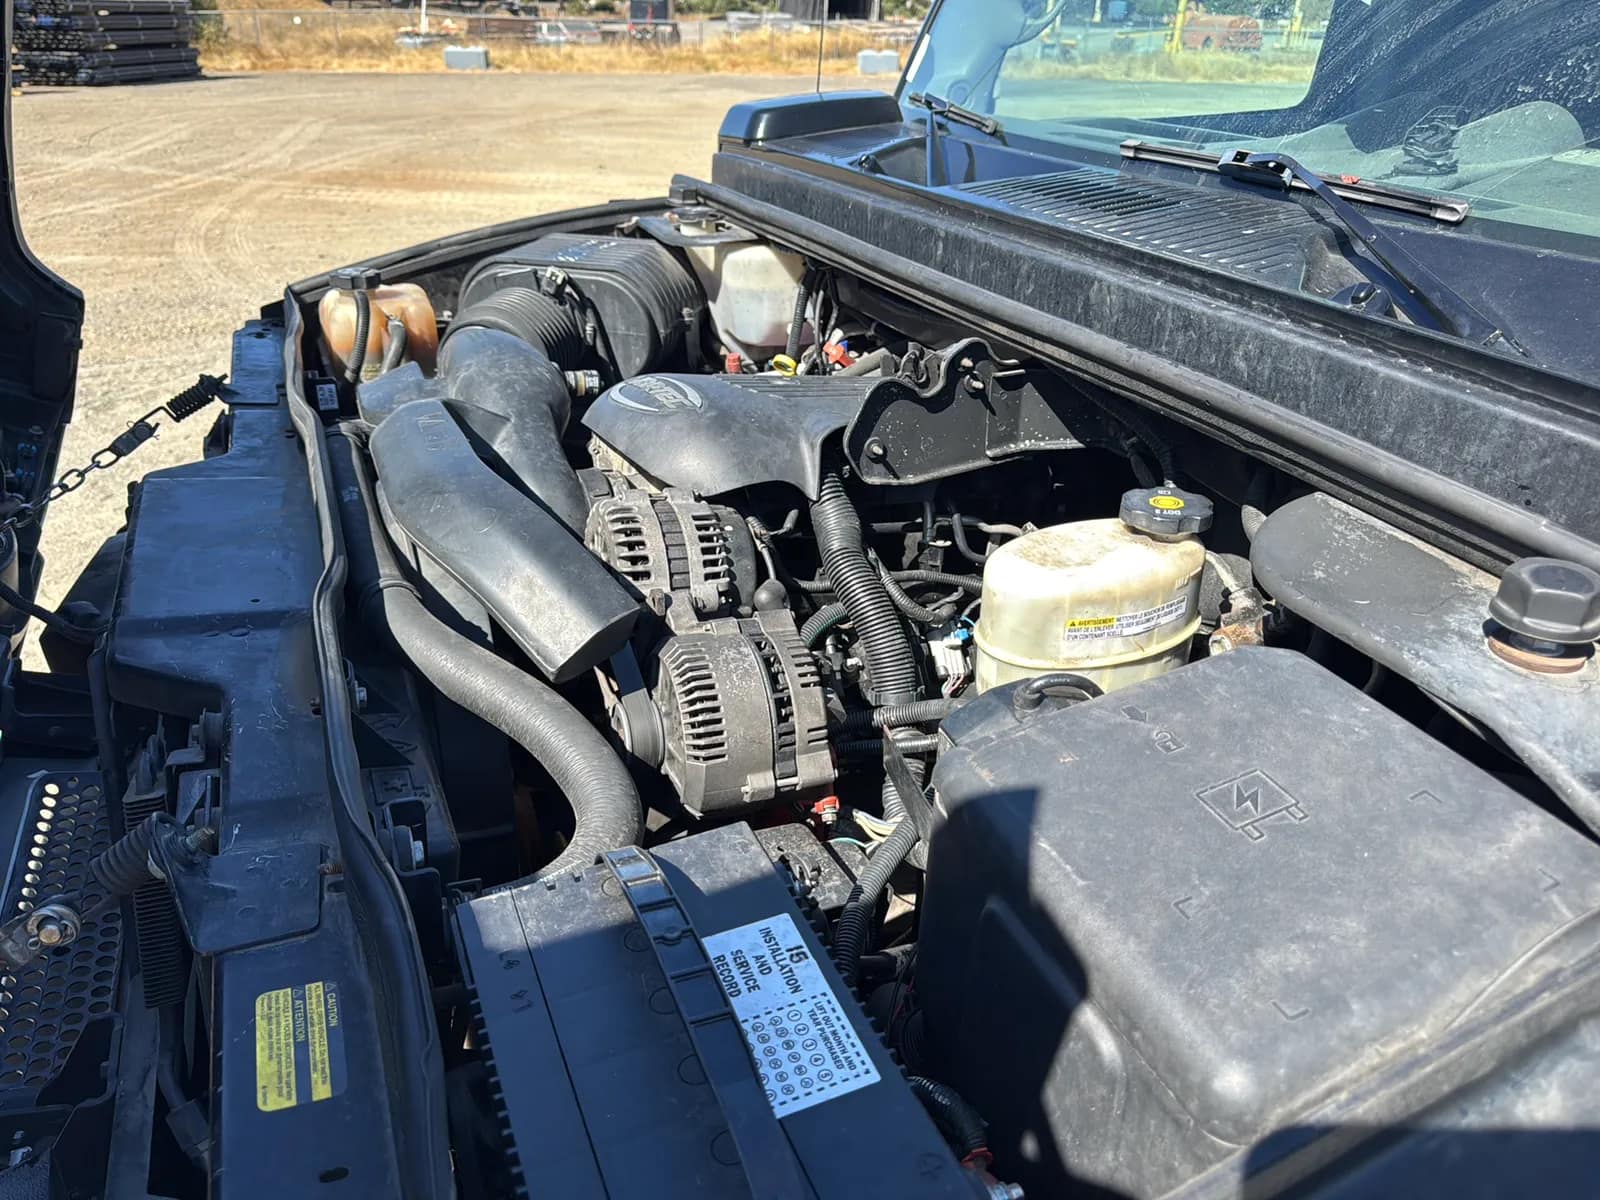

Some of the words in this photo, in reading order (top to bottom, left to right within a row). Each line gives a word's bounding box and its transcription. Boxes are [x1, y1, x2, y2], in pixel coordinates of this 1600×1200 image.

[713, 954, 742, 999] RECORD
[730, 949, 761, 993] SERVICE
[752, 954, 773, 977] AND
[758, 926, 804, 995] INSTALLATION
[294, 999, 306, 1042] ATTENTION
[327, 992, 339, 1027] CAUTION
[807, 1008, 822, 1028] YEAR
[816, 1027, 845, 1070] PURCHASED
[814, 1001, 828, 1015] LIFT
[822, 1015, 835, 1029] OUT
[830, 1028, 849, 1055] MONTH
[842, 1055, 857, 1071] AND
